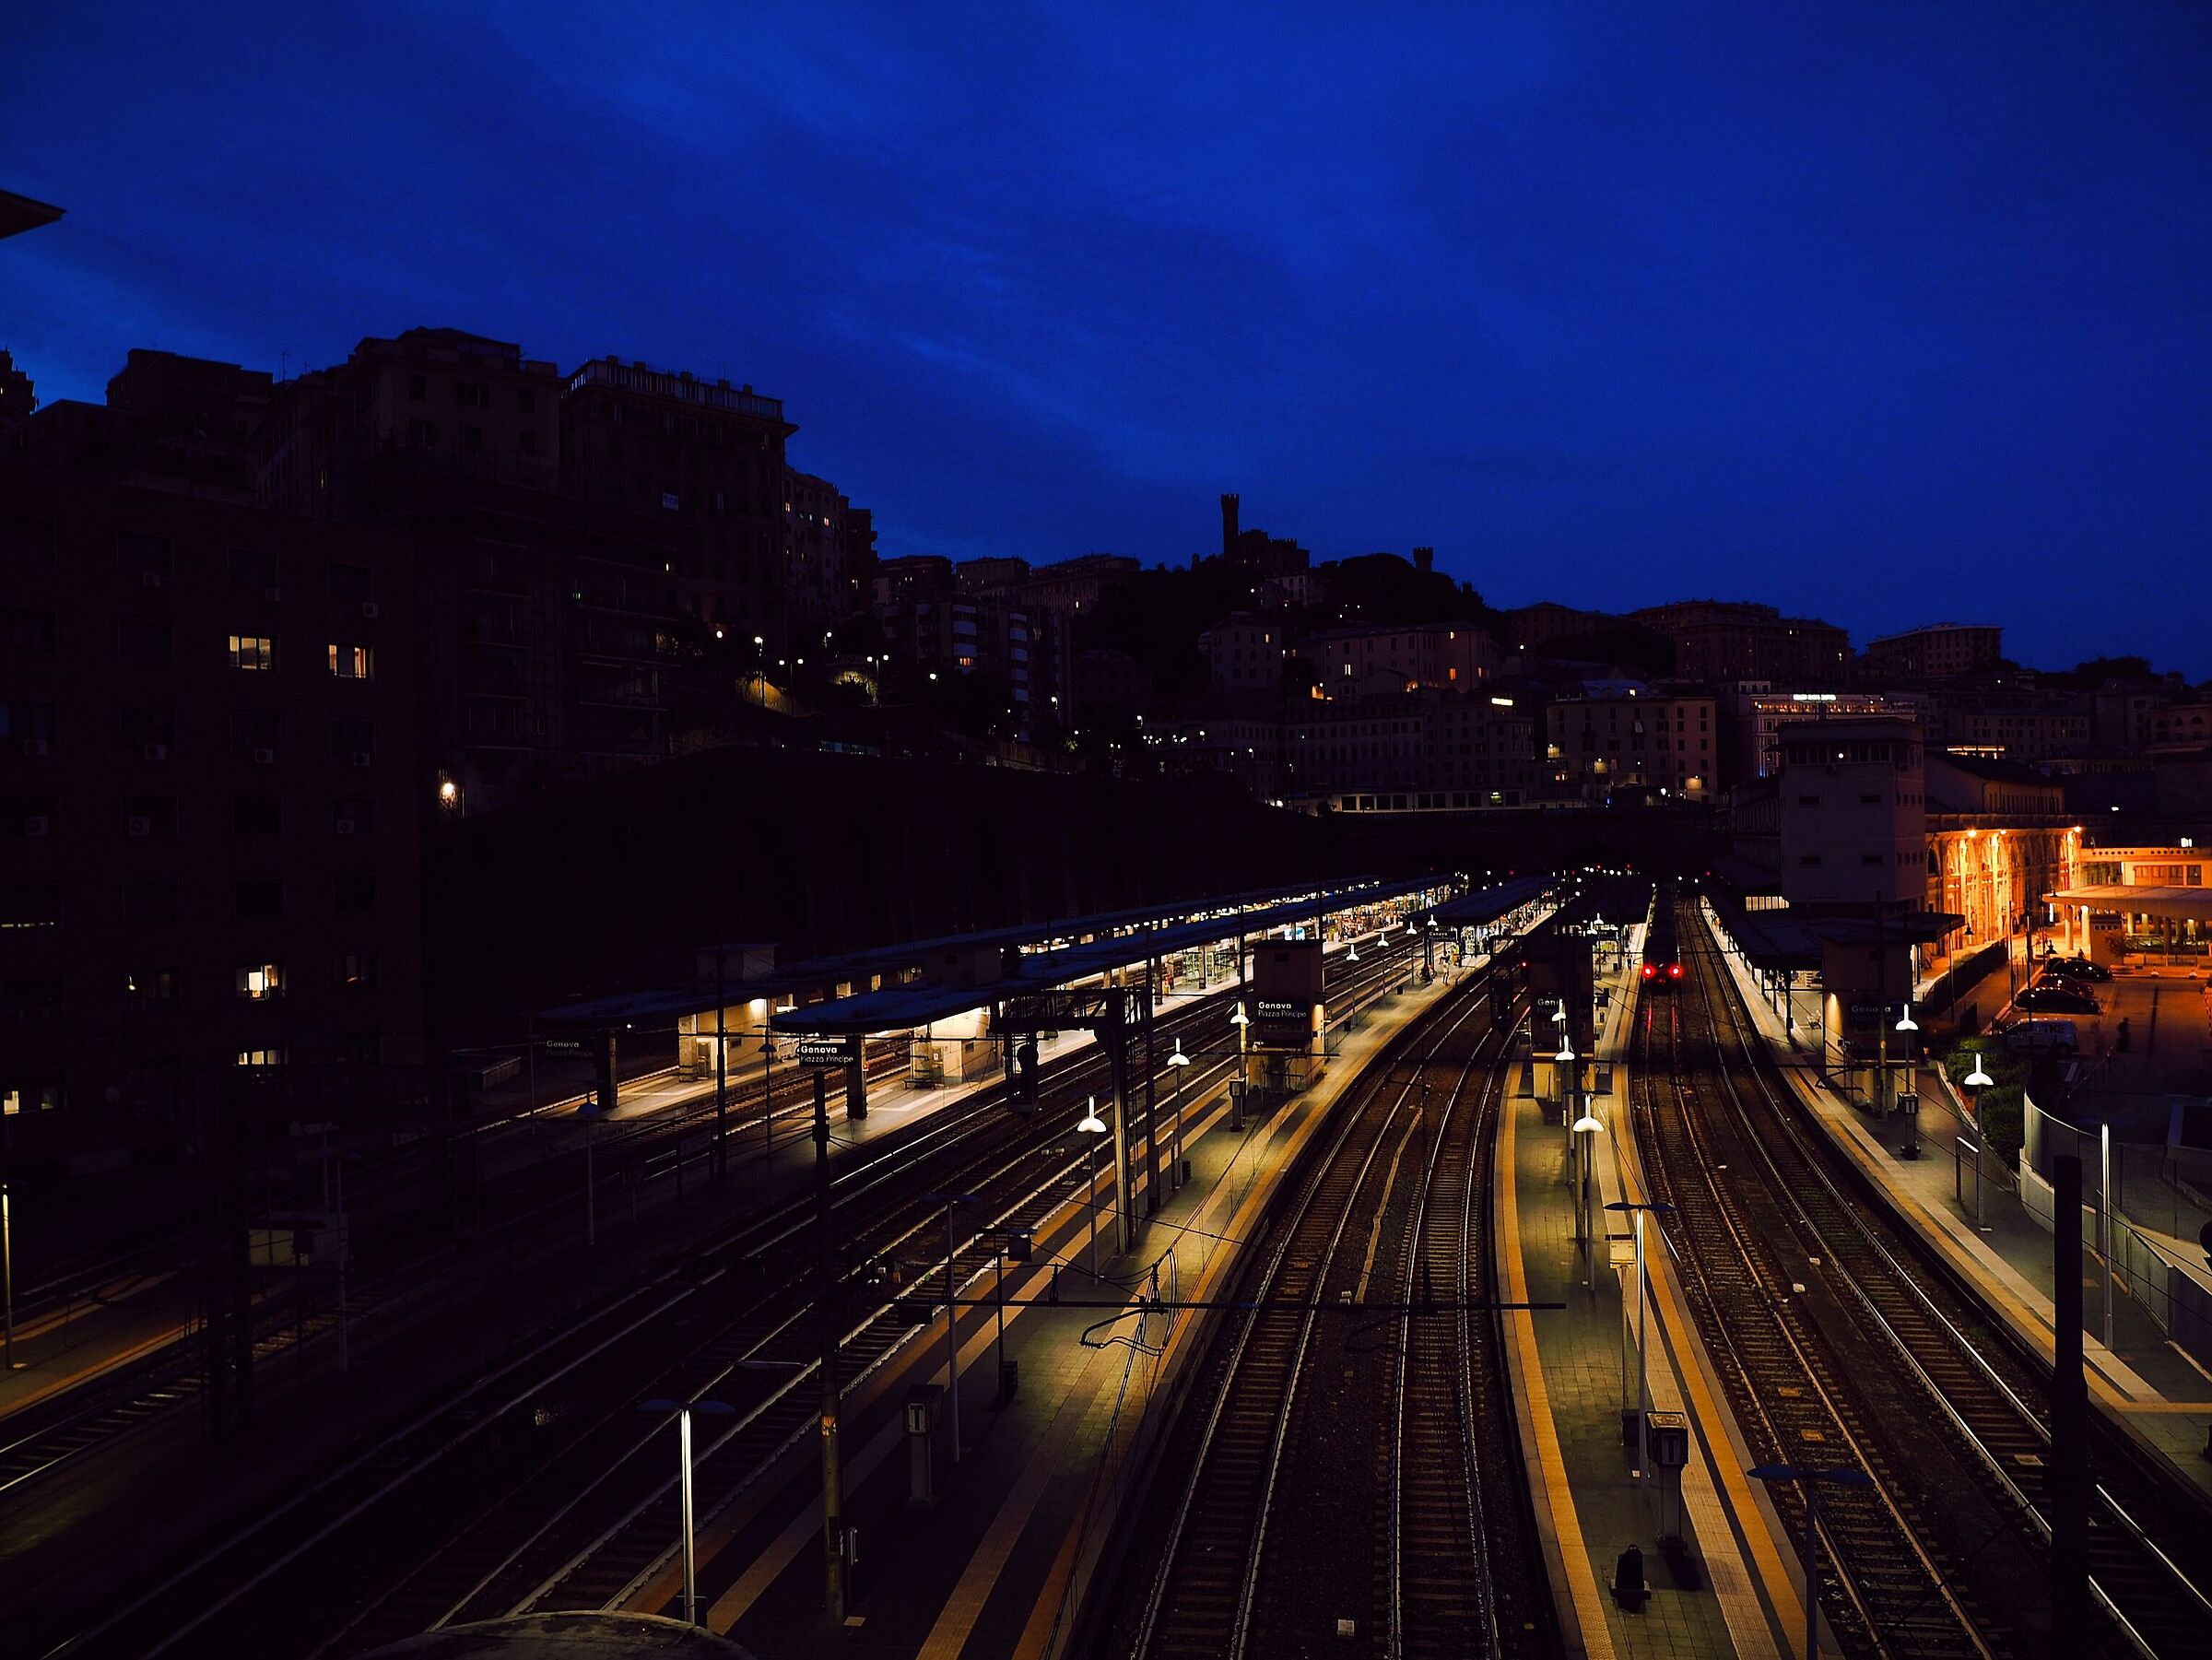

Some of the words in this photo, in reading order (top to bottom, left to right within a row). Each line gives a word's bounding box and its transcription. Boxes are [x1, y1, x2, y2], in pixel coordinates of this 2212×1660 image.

[1257, 1001, 1292, 1009] Genova
[1851, 1005, 1891, 1013] Genoa
[1257, 1009, 1280, 1018] Piazza
[1281, 1009, 1307, 1019] Principe
[547, 1040, 580, 1049] Genova
[800, 1045, 838, 1054] Genova
[800, 1054, 824, 1063] Piazza
[826, 1054, 853, 1065] Principe
